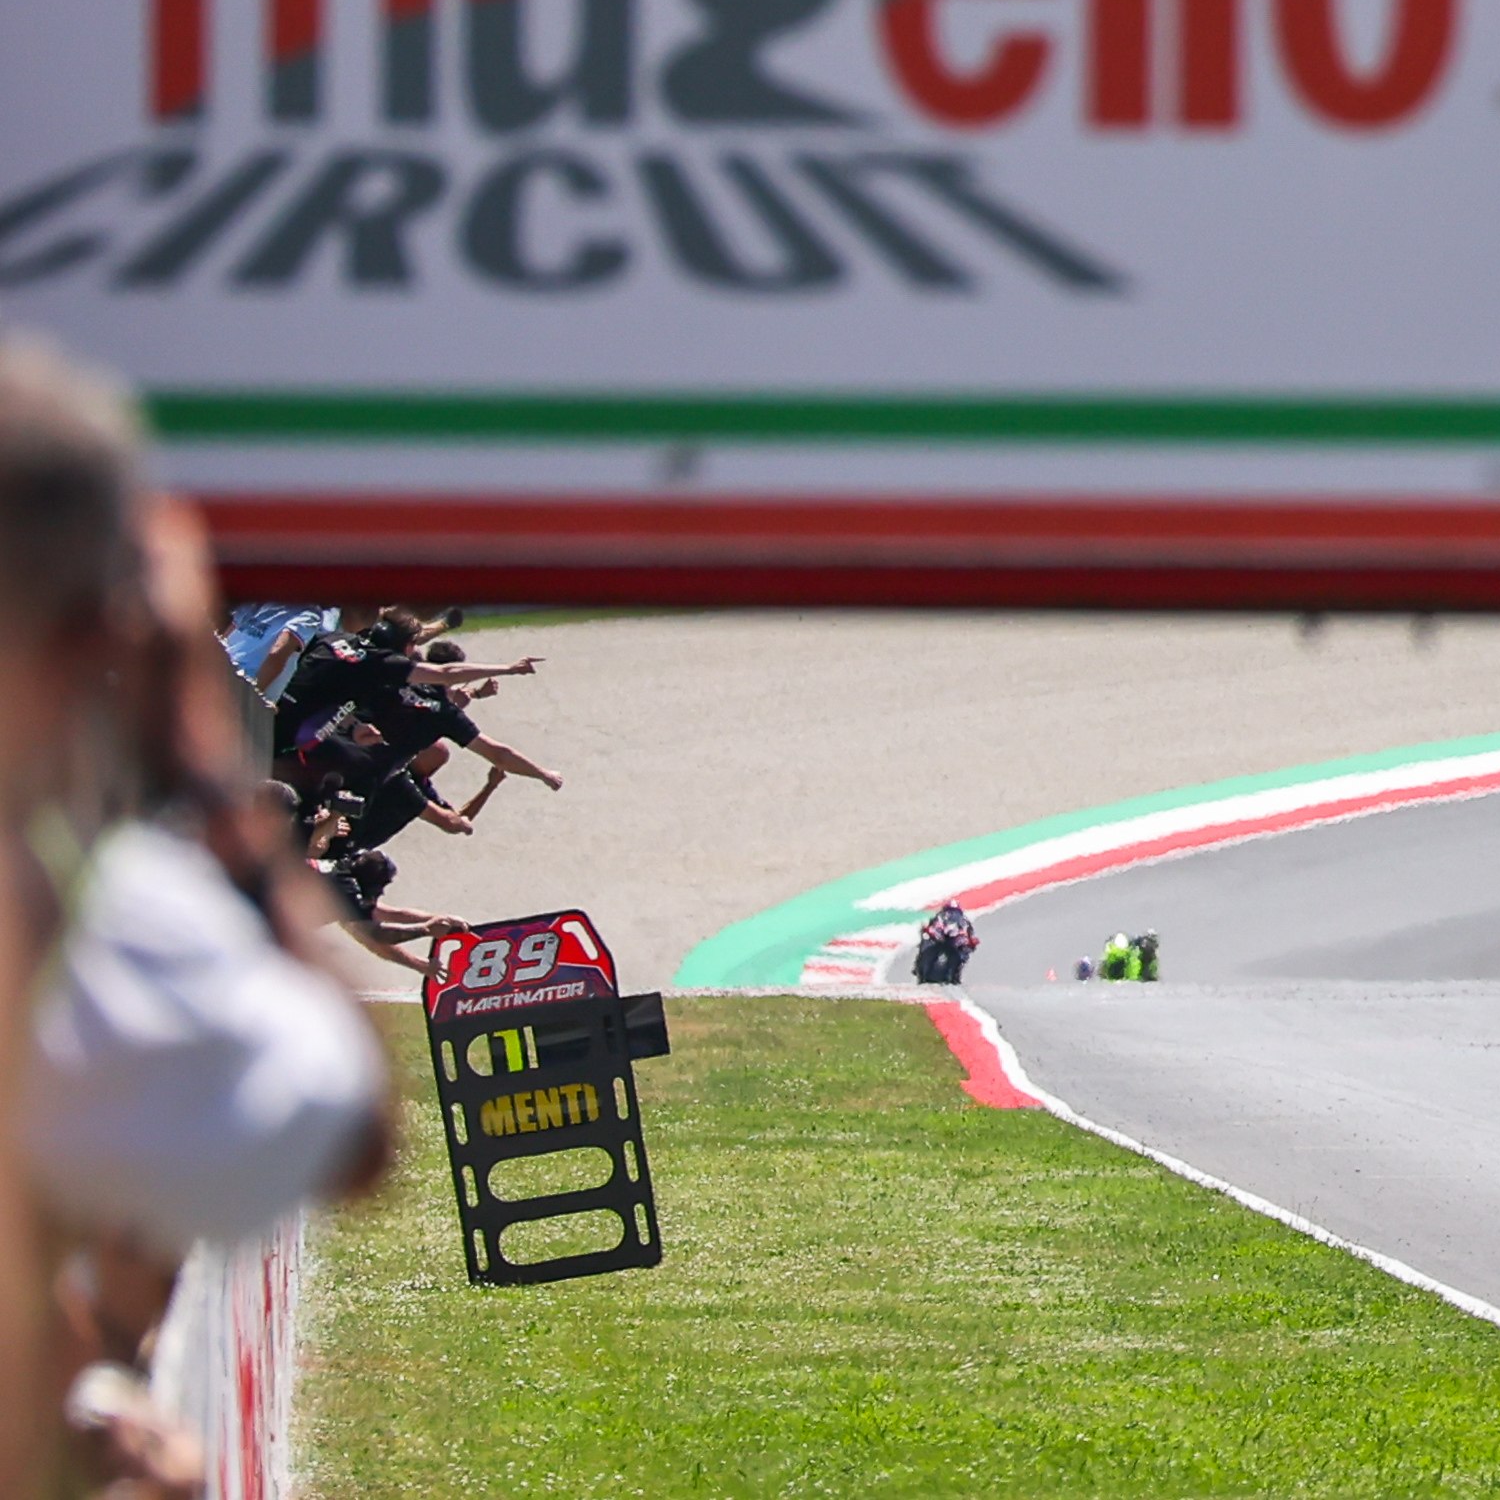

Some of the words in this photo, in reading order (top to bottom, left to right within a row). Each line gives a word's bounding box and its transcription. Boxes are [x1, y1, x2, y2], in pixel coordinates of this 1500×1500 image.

[0, 144, 1132, 297] CIRCUIT
[462, 931, 561, 989] 89
[455, 980, 586, 1016] MARTINATOR
[493, 1028, 524, 1072] 1
[480, 1083, 601, 1137] MENTI
